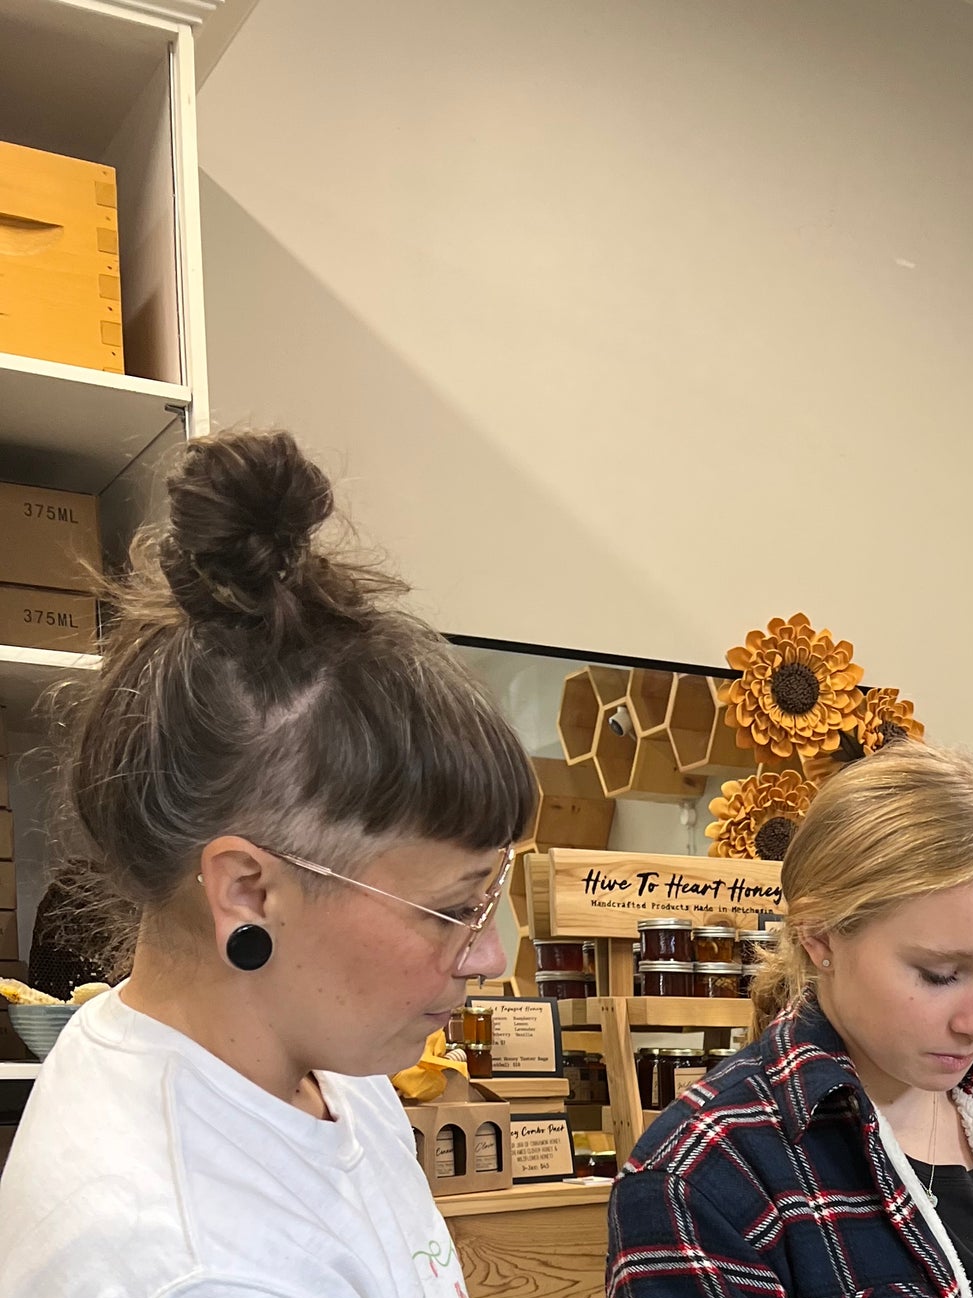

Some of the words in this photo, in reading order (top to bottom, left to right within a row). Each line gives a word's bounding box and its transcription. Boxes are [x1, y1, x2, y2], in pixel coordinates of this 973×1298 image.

[23, 502, 79, 524] 375ML
[23, 608, 79, 629] 375ML
[581, 868, 632, 895] Hive
[637, 872, 660, 897] To
[665, 873, 726, 899] Heart
[727, 878, 784, 906] Honey
[590, 899, 647, 909] Handcrafted
[651, 902, 690, 911] Products
[693, 904, 714, 912] Made
[718, 905, 728, 913] in
